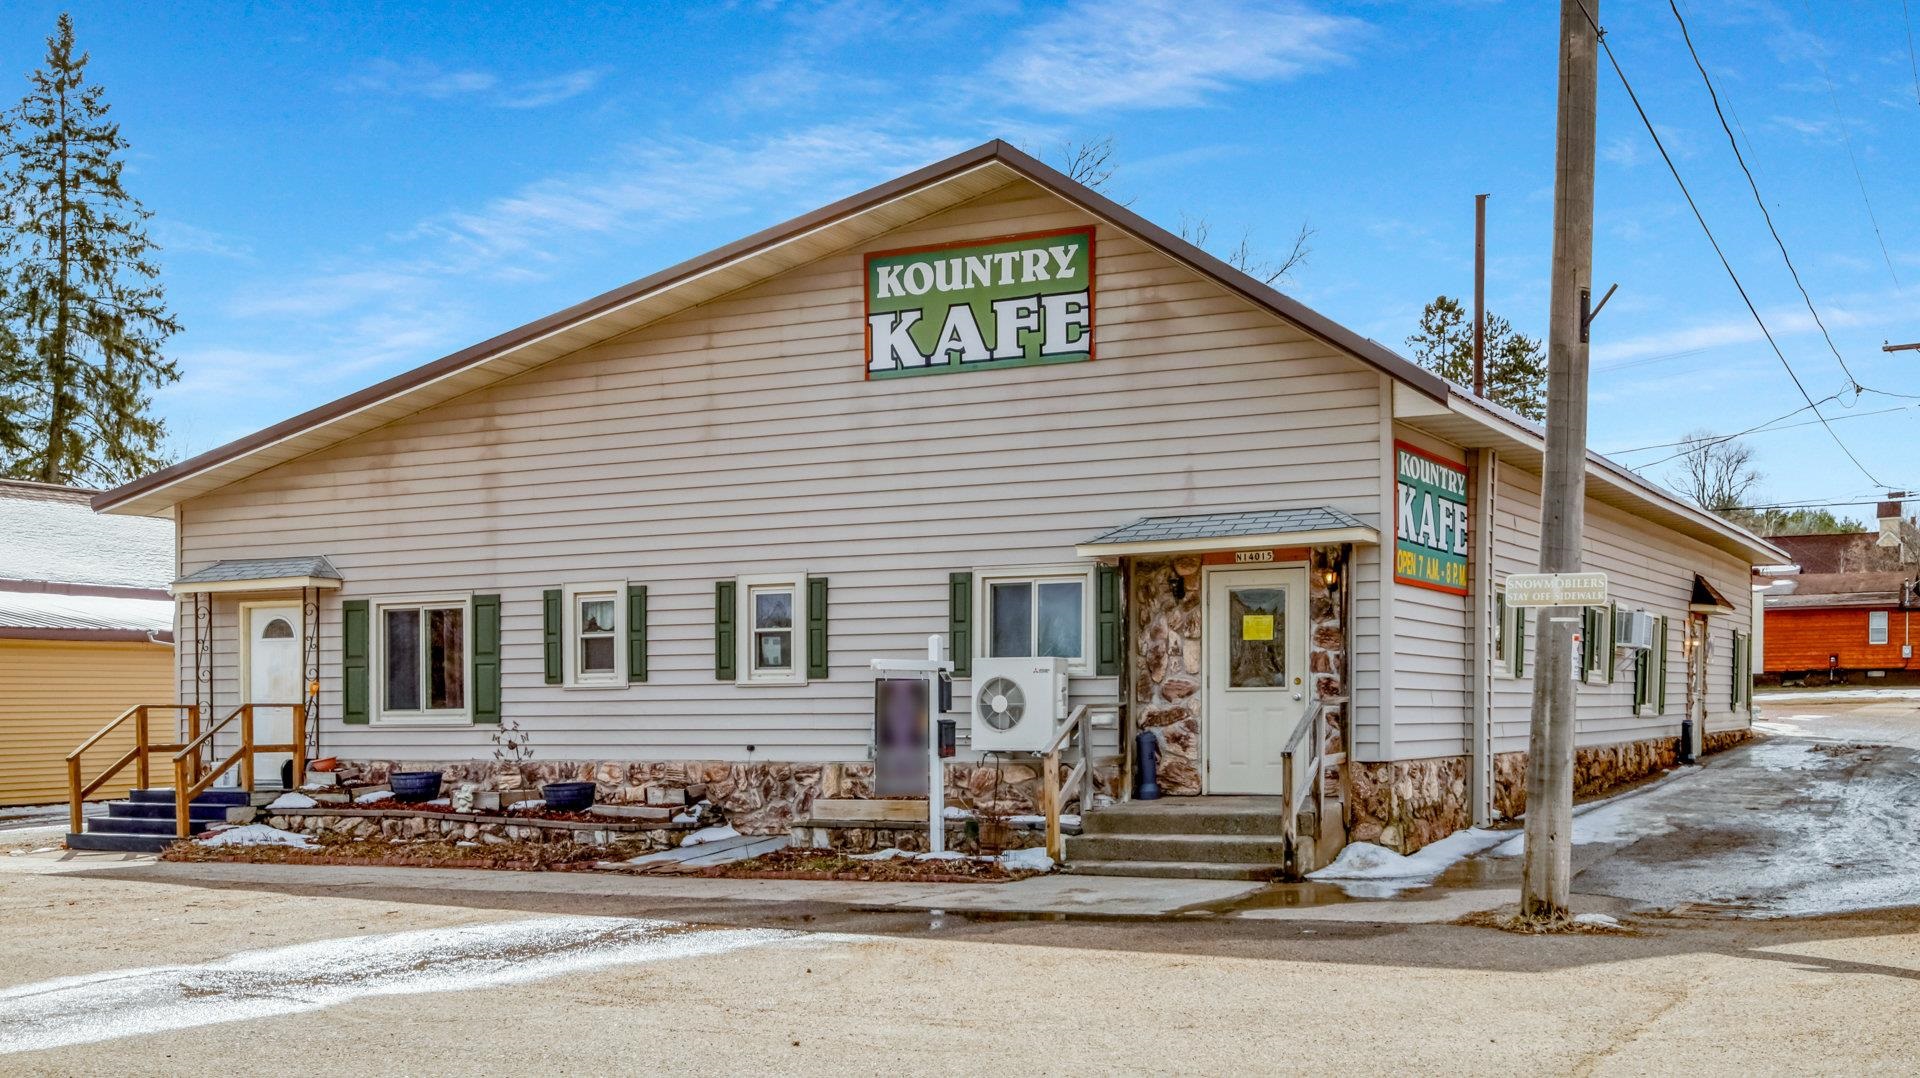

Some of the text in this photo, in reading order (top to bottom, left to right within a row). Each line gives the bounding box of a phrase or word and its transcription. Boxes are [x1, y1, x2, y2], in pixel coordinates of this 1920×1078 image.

[877, 244, 1079, 299] KOUNTRY
[869, 290, 1090, 373] KAFE
[1399, 451, 1465, 496] KOUNTRY
[1397, 480, 1468, 557] KAFE
[1236, 552, 1272, 561] N14015
[1397, 549, 1416, 576] OPEN
[1418, 555, 1424, 577] 7
[1446, 561, 1452, 584] 8
[1507, 578, 1605, 590] SNOWMOBILERS
[1507, 591, 1605, 601] STAY OFF SIDEWALK
